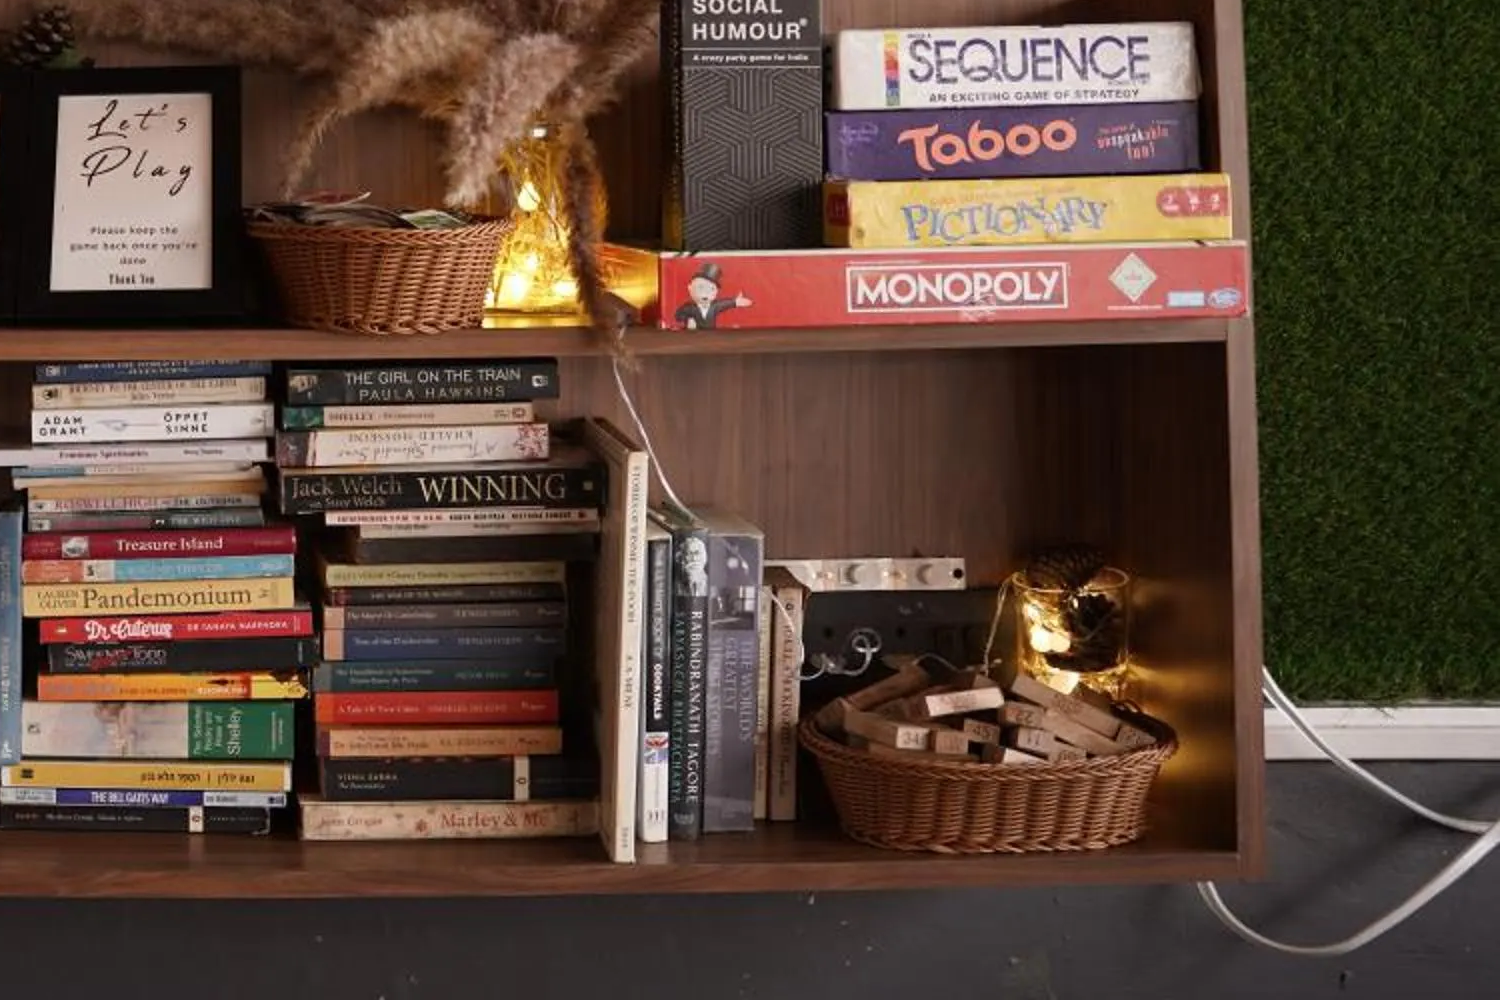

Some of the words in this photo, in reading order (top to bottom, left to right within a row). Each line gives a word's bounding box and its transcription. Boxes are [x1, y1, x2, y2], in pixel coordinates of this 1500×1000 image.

[691, 21, 801, 41] HUMOUR
[907, 35, 1151, 84] SEQUENCE
[929, 93, 948, 103] AN
[951, 90, 1011, 102] EXCITING
[1013, 90, 1050, 101] GAME
[1055, 89, 1071, 100] OF
[1074, 88, 1140, 100] STRATEGY
[86, 98, 189, 142] Let's
[897, 118, 1078, 173] Taboo
[80, 145, 194, 197] Play
[900, 196, 1108, 242] PICTIONARY
[89, 226, 126, 235] Please
[129, 226, 156, 236] keep
[159, 226, 179, 235] the
[102, 242, 127, 250] back
[856, 270, 1060, 305] MONOPOLY
[346, 371, 374, 386] THE
[378, 371, 413, 386] GIRL
[417, 370, 440, 384] ON
[444, 369, 473, 383] THE
[477, 367, 522, 383] TRAIN
[358, 388, 415, 402] PAULA
[425, 385, 506, 400] HAWKINS
[43, 415, 84, 426] ADAM
[165, 424, 209, 434] SINNE
[39, 426, 87, 437] GRANT
[291, 477, 334, 500] Jack
[339, 473, 404, 497] Welch
[417, 473, 567, 503] WINNING
[115, 538, 177, 553] Treasure
[179, 536, 224, 551] Island
[81, 585, 252, 610] Pandemonium
[84, 620, 110, 640] Dr
[687, 610, 703, 734] RABINDRANATH
[652, 663, 663, 720] COCKTAILS
[685, 741, 700, 805] TAGORE
[440, 812, 501, 831] Marley
[501, 810, 518, 827] &
